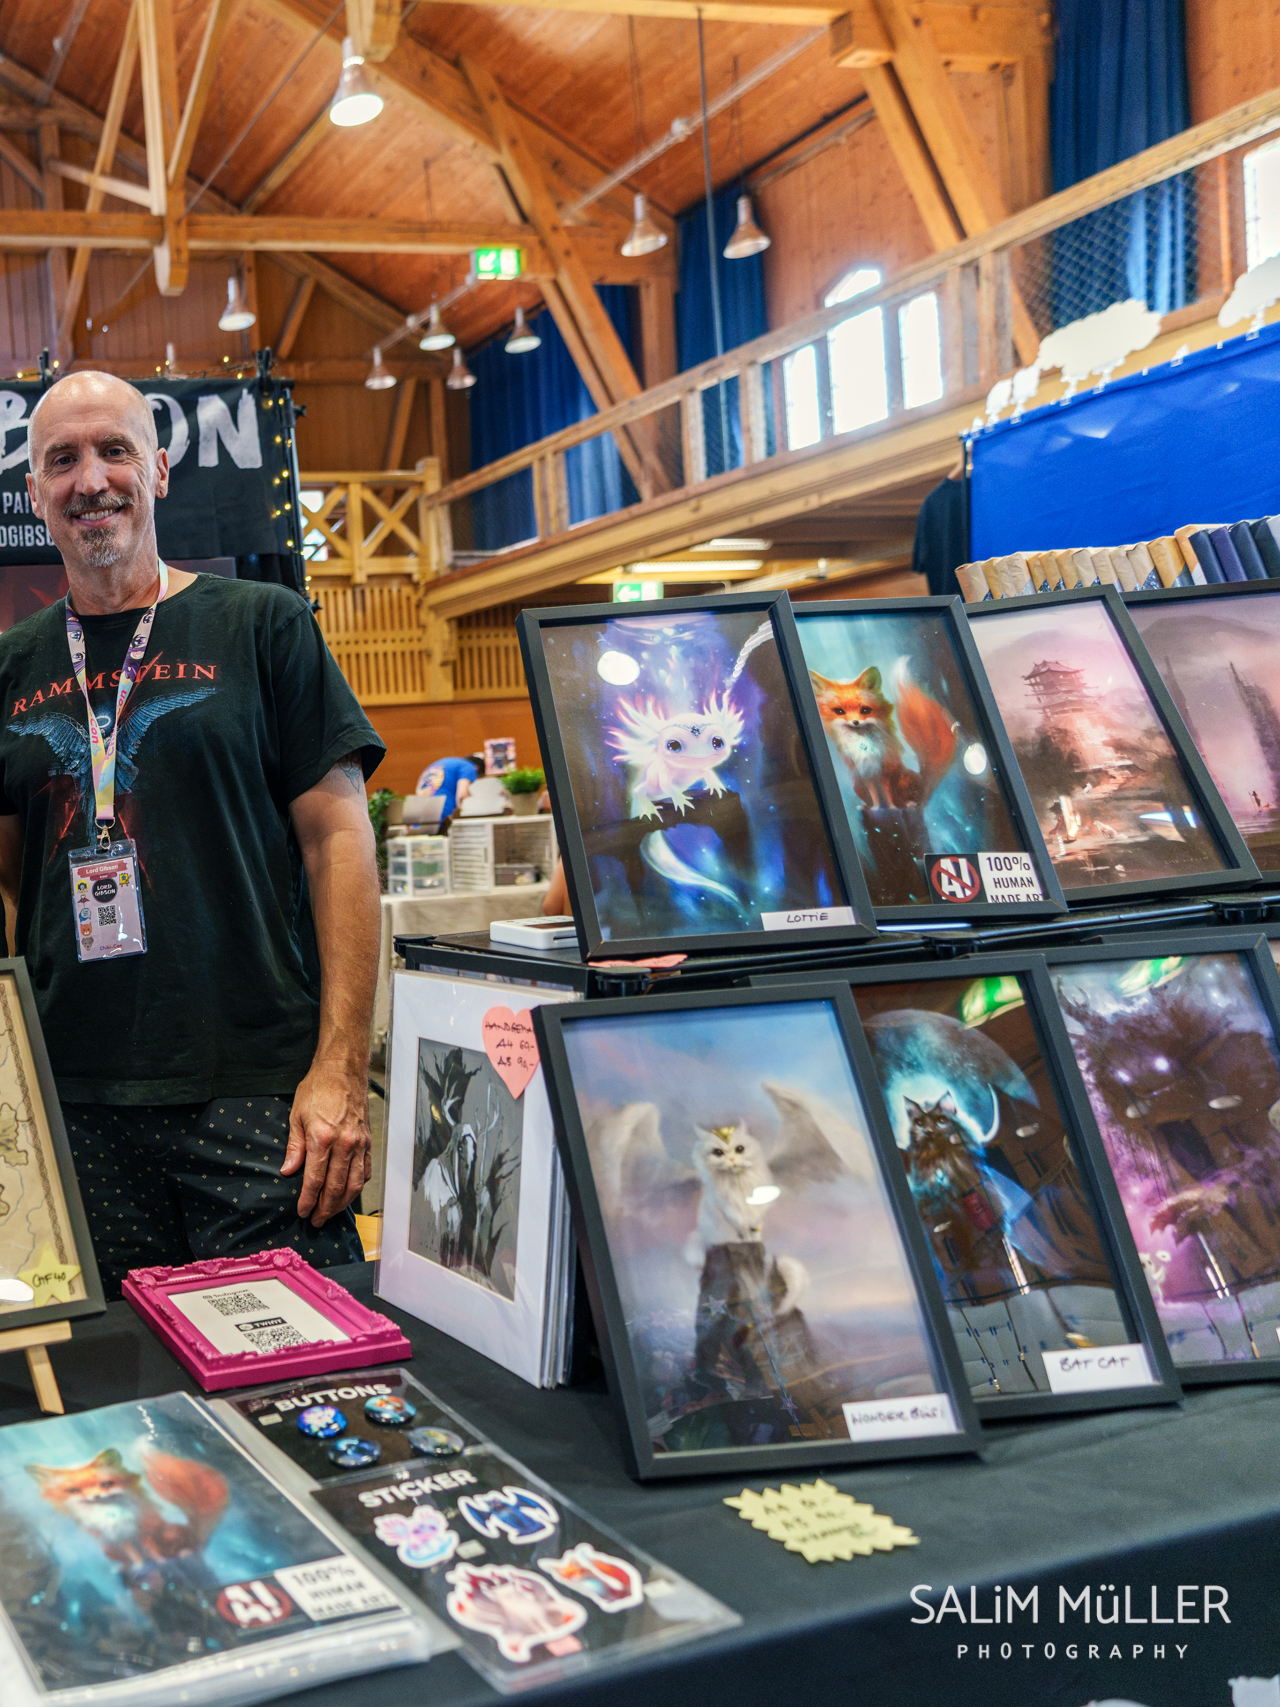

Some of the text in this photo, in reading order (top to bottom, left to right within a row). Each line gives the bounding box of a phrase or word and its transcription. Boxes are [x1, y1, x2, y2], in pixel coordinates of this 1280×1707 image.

[11, 662, 217, 717] RAMMSTEIN
[100, 864, 119, 872] Gibson
[986, 856, 1031, 872] 100%
[992, 876, 1035, 889] HUMAN
[496, 1038, 513, 1049] A4
[1058, 1355, 1131, 1372] BAT CAT
[274, 1383, 393, 1412] BUTTONS
[358, 1468, 478, 1508] STICKER
[291, 1563, 356, 1588] 100%
[309, 1580, 366, 1601] HUMAN
